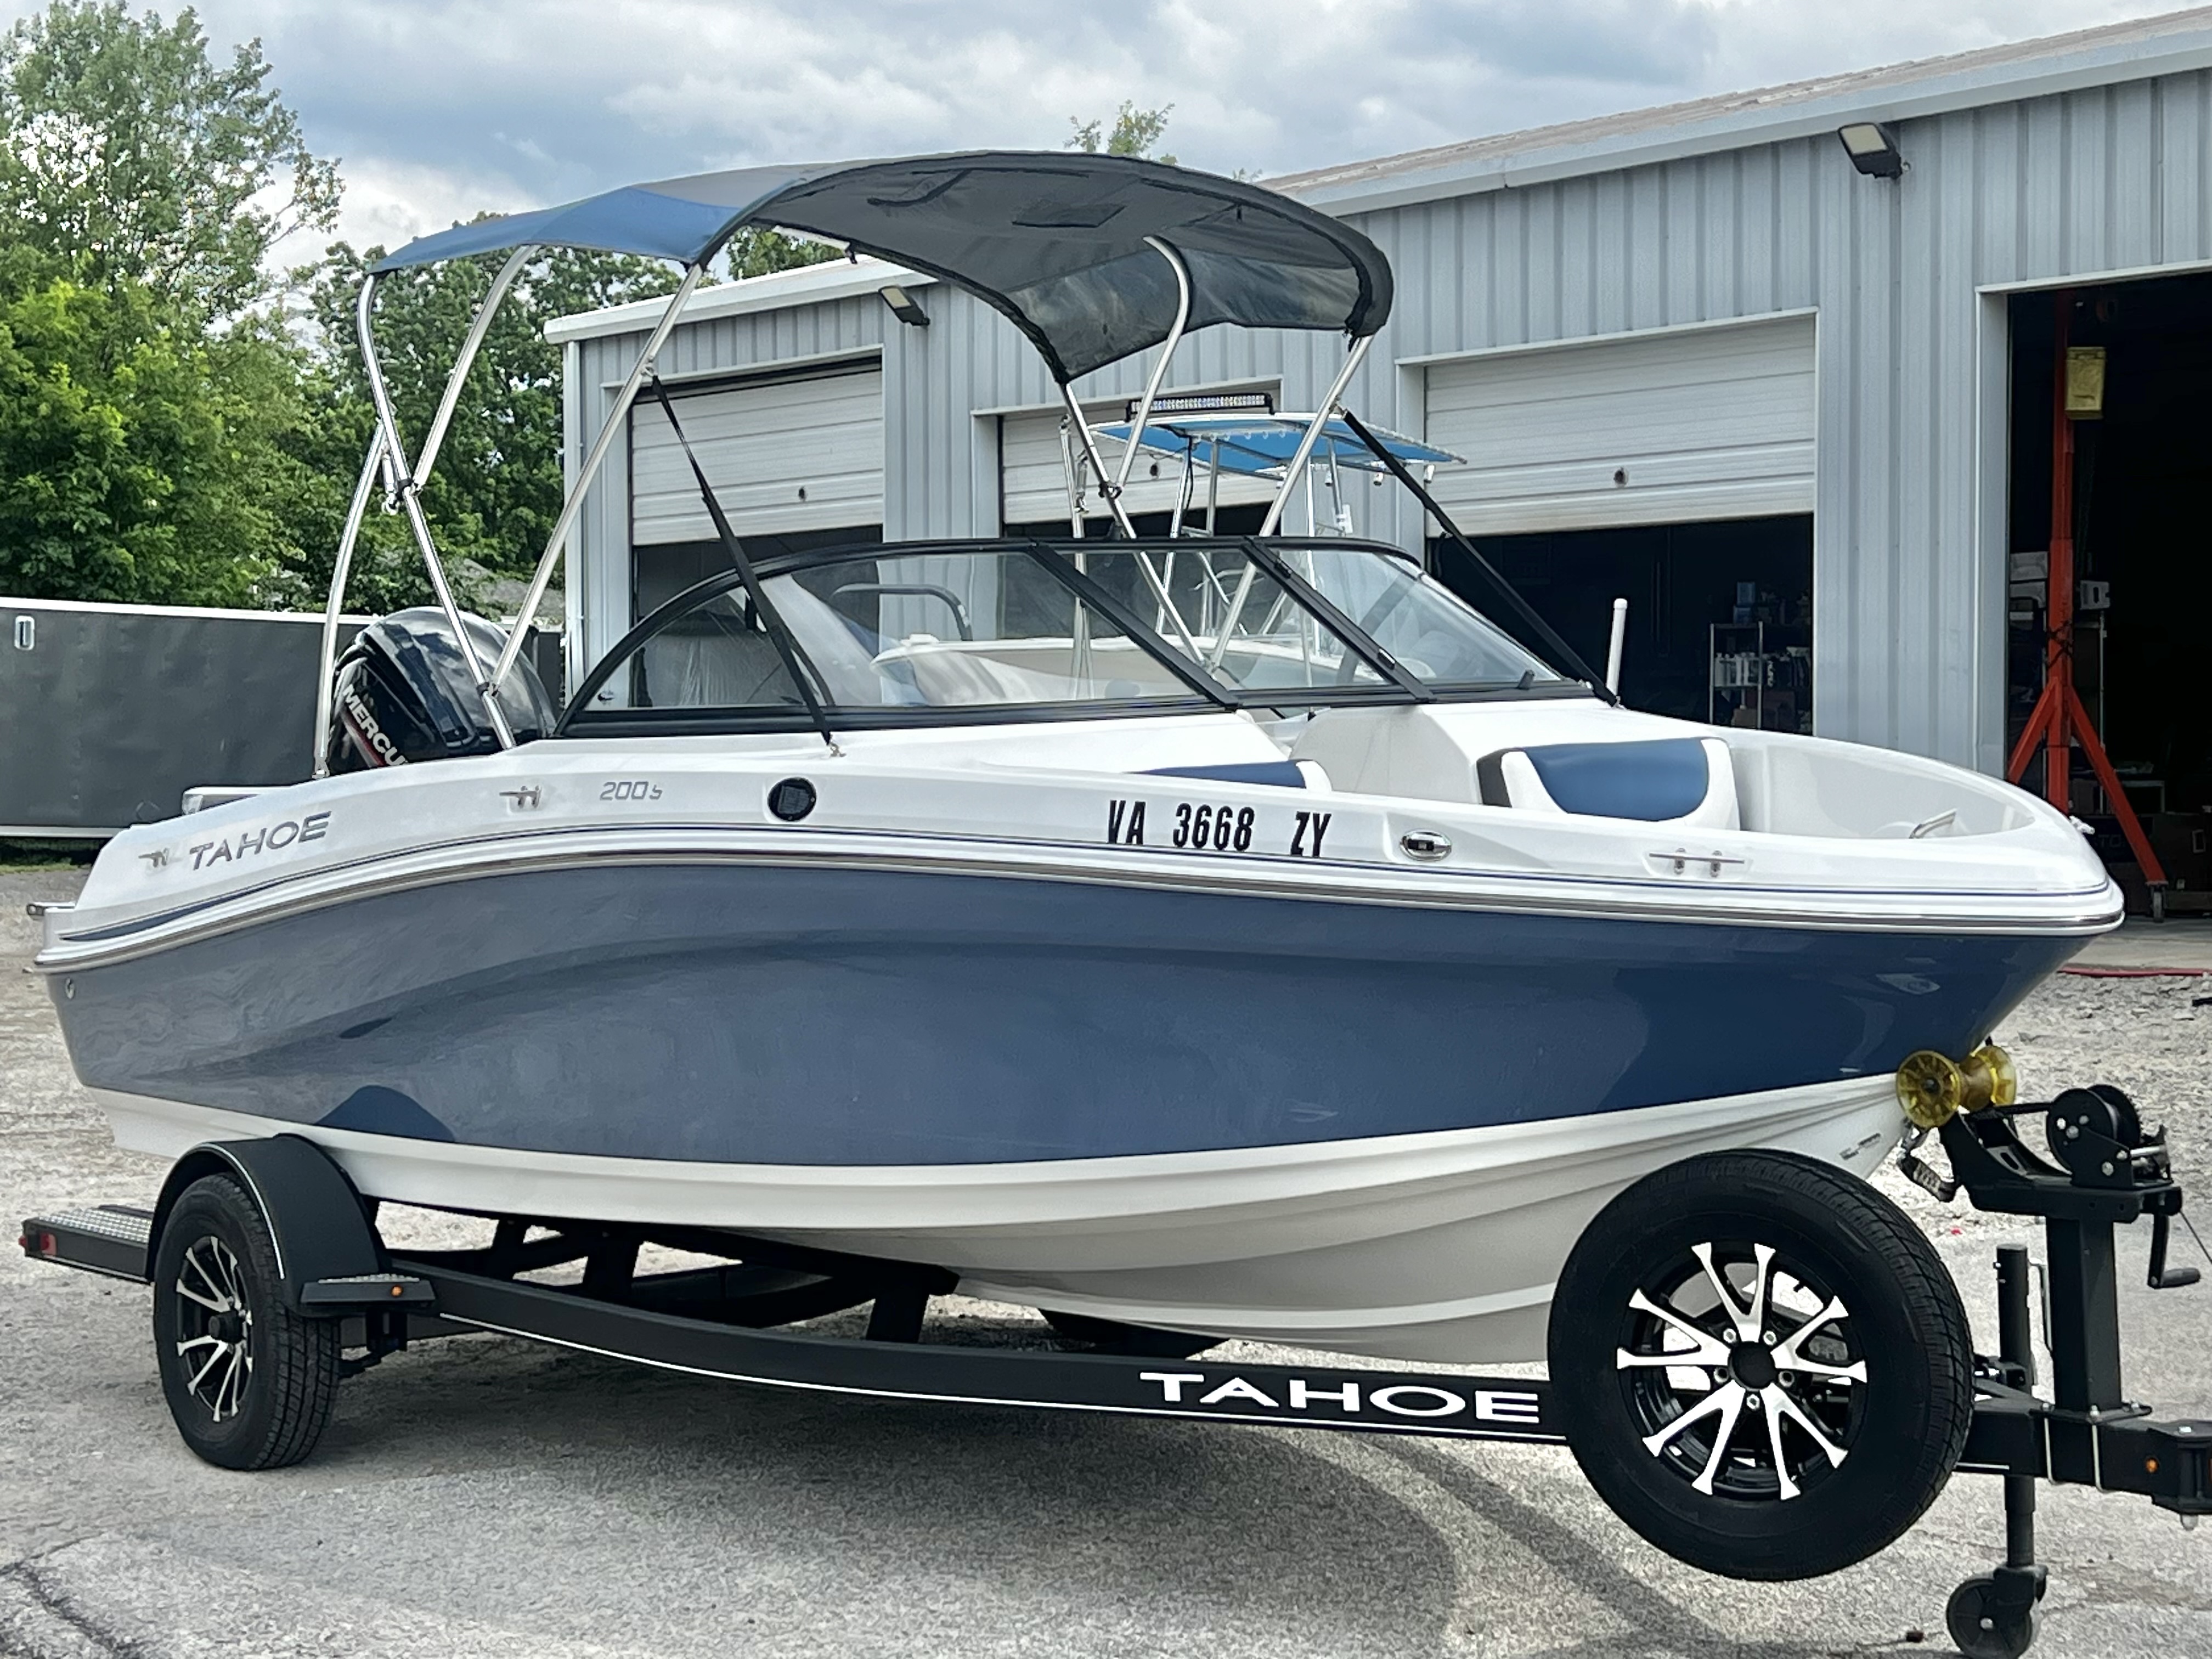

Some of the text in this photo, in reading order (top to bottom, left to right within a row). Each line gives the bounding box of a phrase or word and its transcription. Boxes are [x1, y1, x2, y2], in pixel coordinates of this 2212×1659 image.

[343, 684, 408, 766] MERCU
[189, 810, 332, 871] TAHOE
[1107, 799, 1332, 857] VA 3668 ZY
[1139, 1372, 1540, 1424] TAHOE
